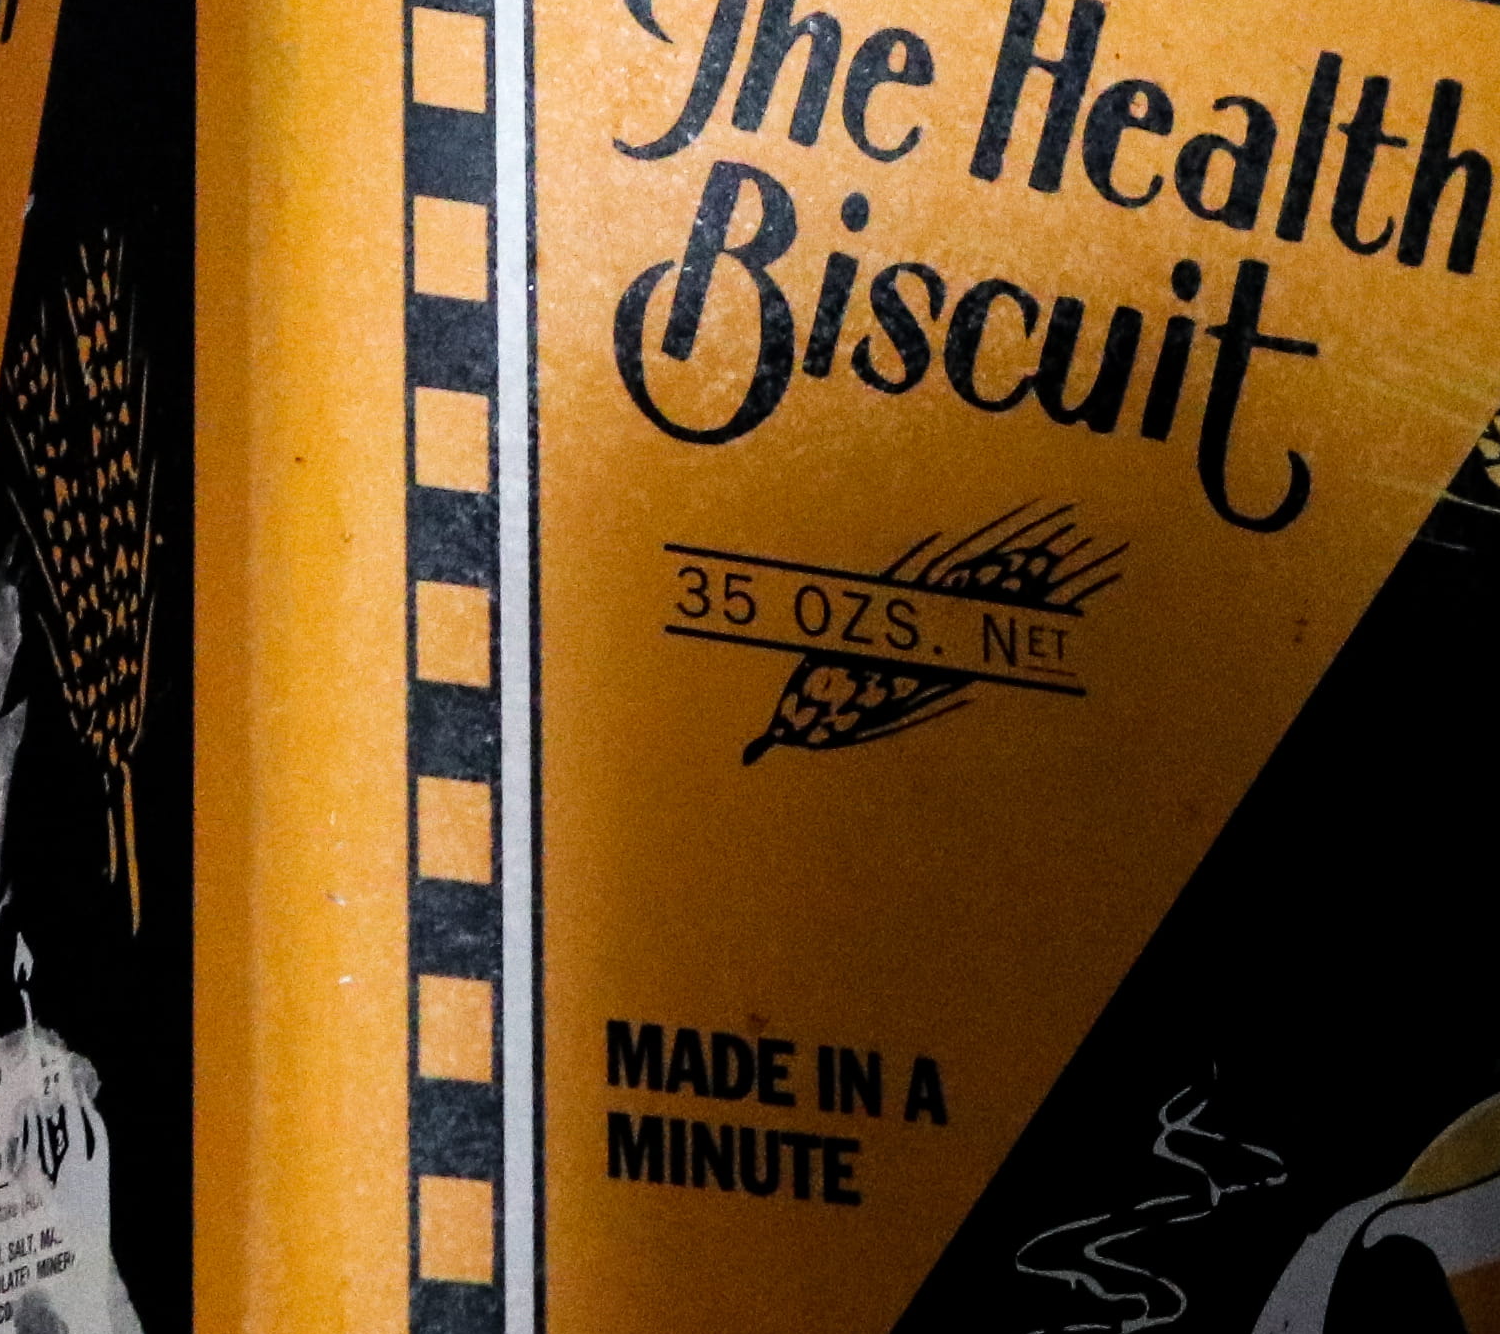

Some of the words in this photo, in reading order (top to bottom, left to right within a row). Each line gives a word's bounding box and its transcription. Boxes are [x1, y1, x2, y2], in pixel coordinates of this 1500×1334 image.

[612, 160, 1319, 534] Biscuit
[675, 564, 757, 627] 35
[604, 1017, 796, 1109] MADE
[816, 1043, 883, 1117] IN
[903, 1055, 949, 1127] A
[604, 1110, 862, 1206] MINUTE
